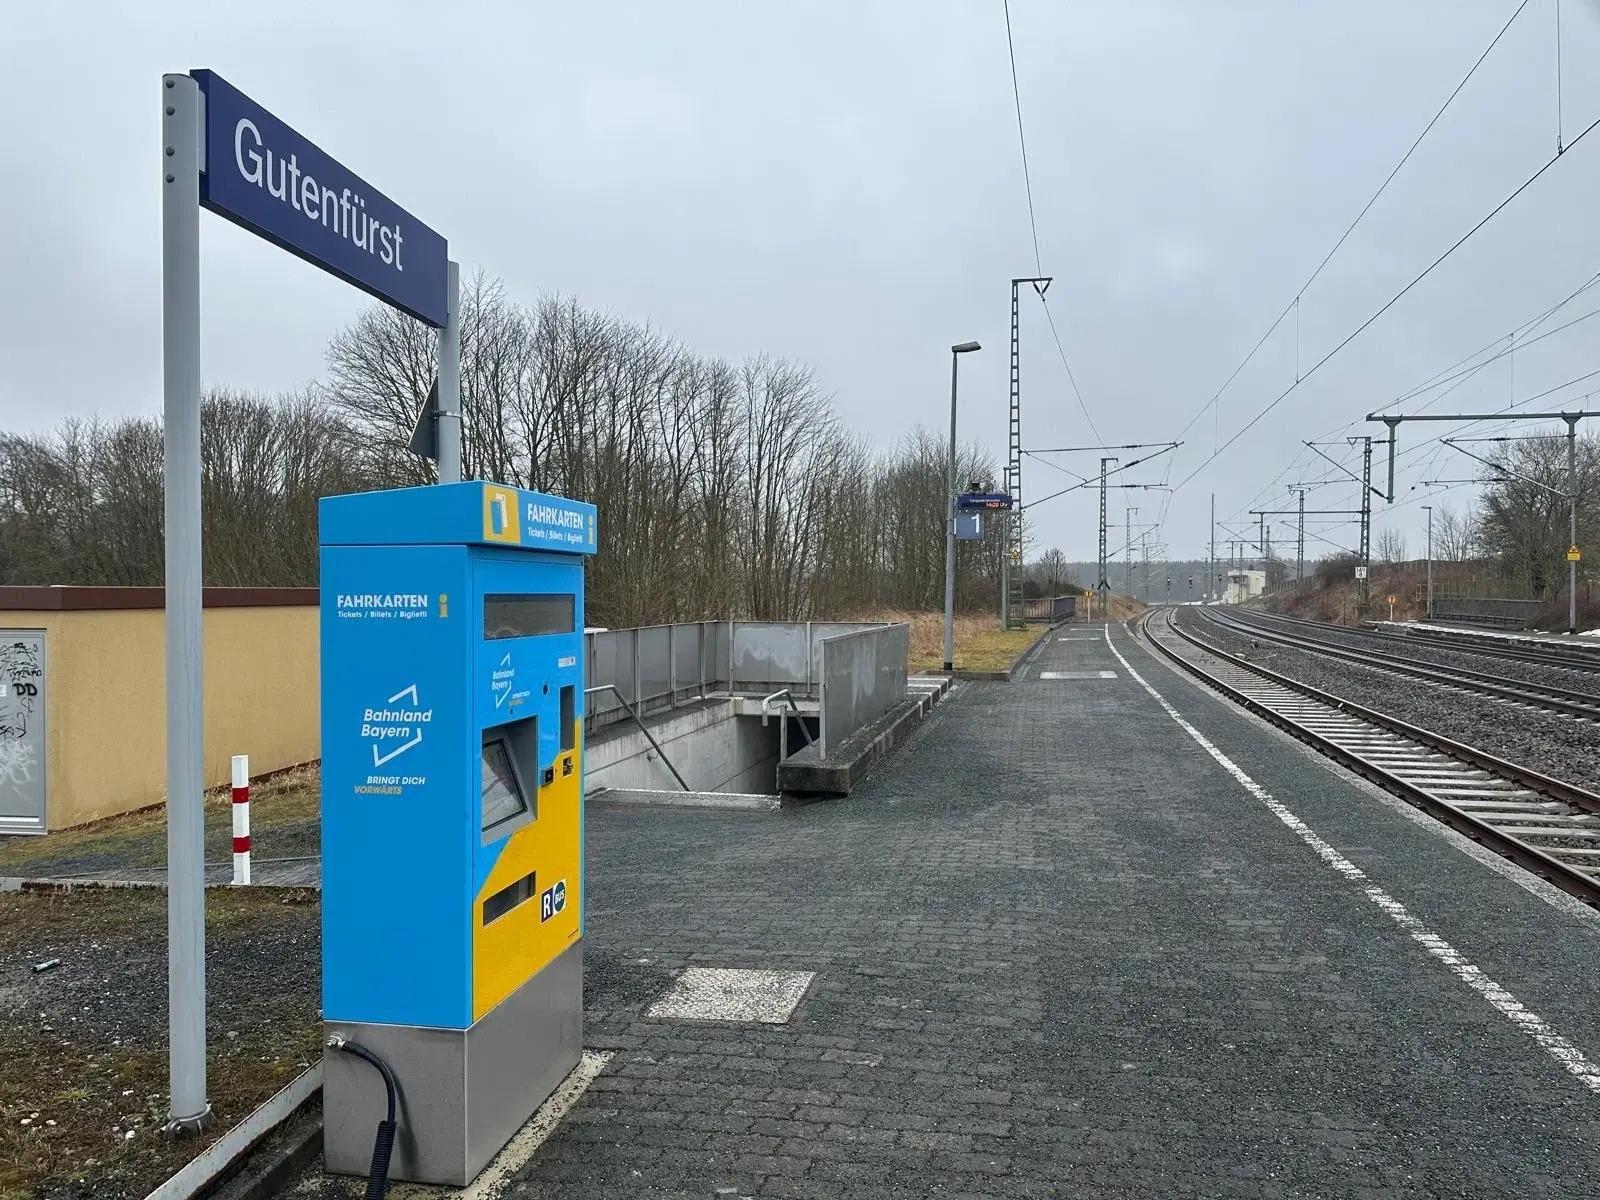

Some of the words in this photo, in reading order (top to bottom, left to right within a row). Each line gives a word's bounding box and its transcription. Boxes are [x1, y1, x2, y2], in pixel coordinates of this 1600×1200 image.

[234, 118, 403, 272] Gutenfürst
[527, 503, 584, 530] FAHRKARTEN
[971, 513, 980, 534] 1
[528, 526, 545, 538] Tickets
[337, 594, 428, 608] FAHRKARTEN
[400, 610, 428, 620] Biglietti
[492, 668, 515, 680] Bahnland
[363, 708, 433, 722] Bahnland
[360, 724, 410, 740] Bayern
[366, 776, 400, 785] BRINGT
[401, 776, 426, 785] DICH
[354, 784, 402, 795] VORWÄRTS
[554, 889, 565, 905] BUS
[543, 893, 551, 919] R
